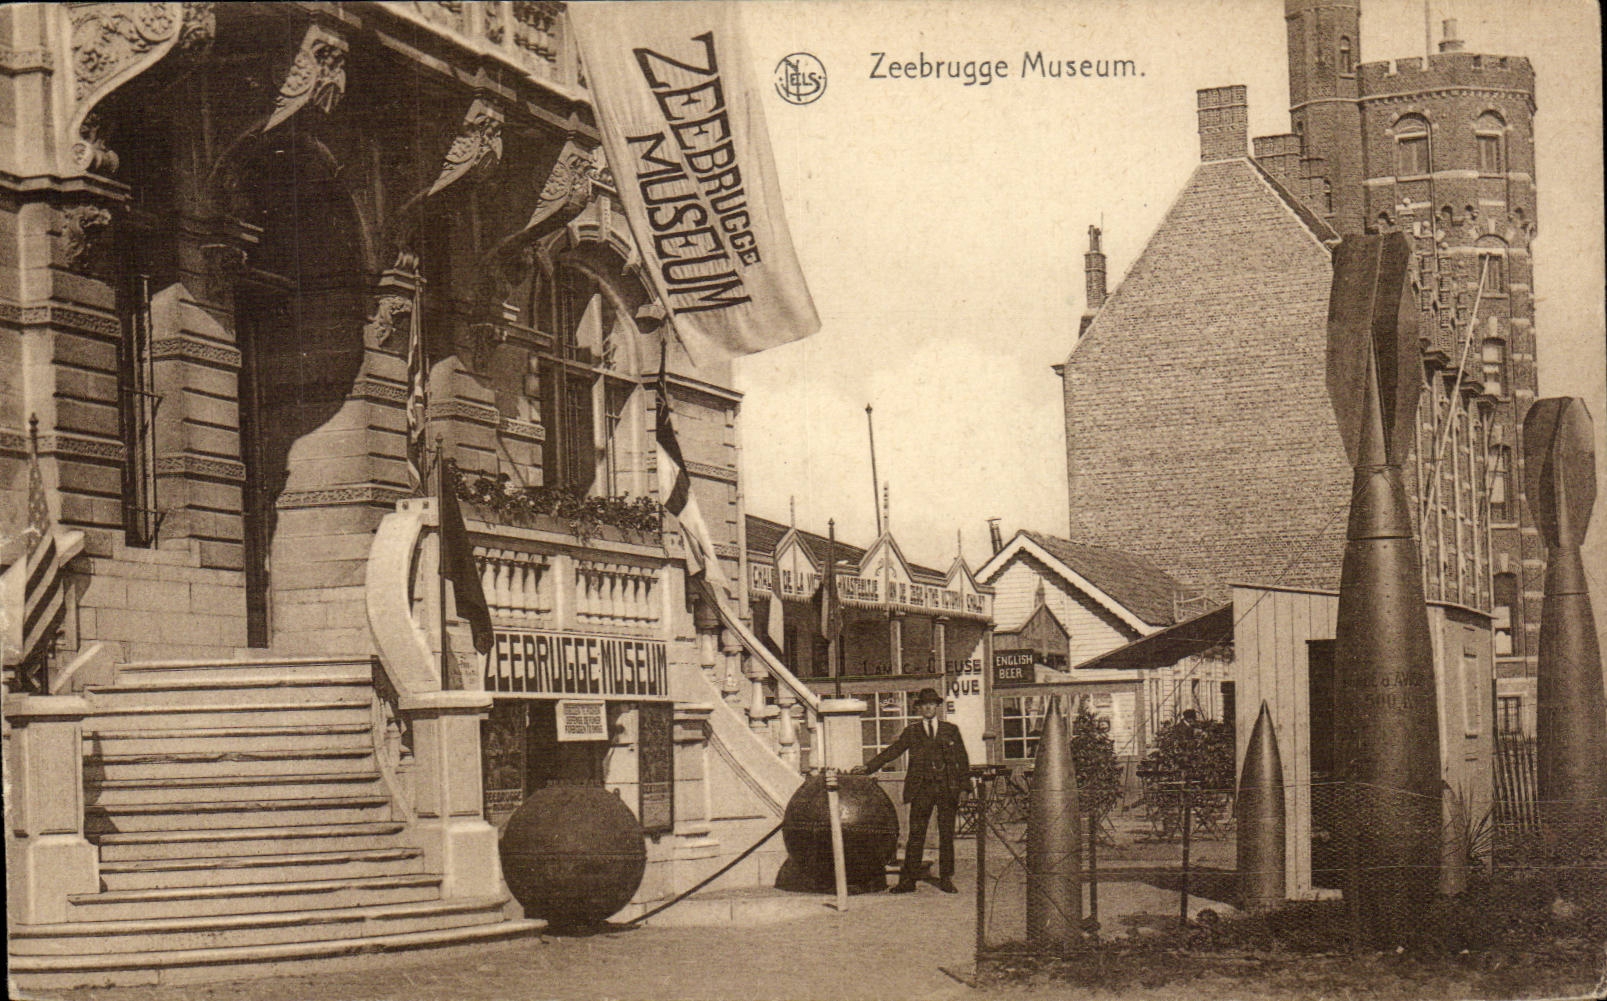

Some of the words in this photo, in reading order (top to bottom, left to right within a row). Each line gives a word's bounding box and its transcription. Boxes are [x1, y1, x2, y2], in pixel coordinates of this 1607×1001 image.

[632, 31, 761, 267] ZEEBRUGGE
[625, 131, 752, 315] MUSEUM
[484, 633, 600, 695] ZEEBRUGGE
[600, 638, 669, 697] MUSEUM
[996, 654, 1033, 666] ENGLISH
[999, 668, 1023, 680] BEER
